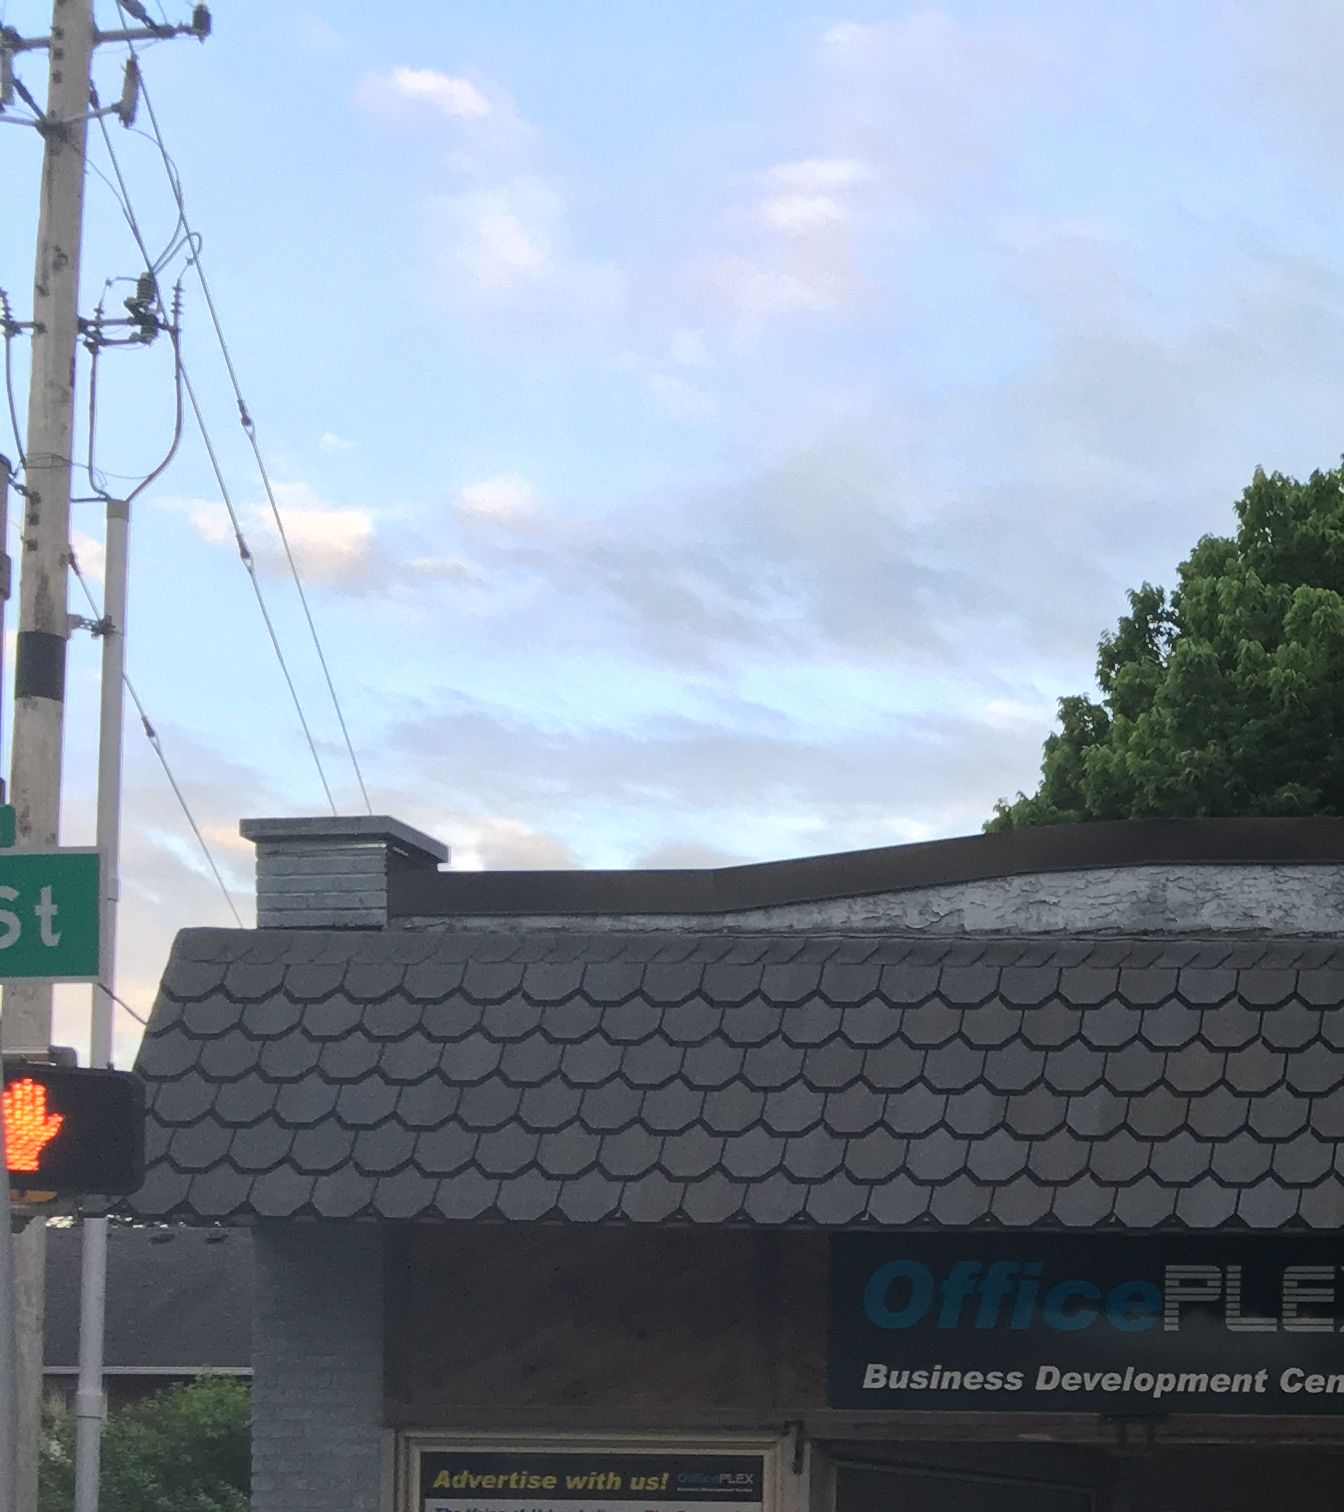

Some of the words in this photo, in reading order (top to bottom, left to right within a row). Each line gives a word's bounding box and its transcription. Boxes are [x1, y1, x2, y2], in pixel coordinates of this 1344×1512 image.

[862, 1363, 1024, 1391] Business
[1035, 1365, 1269, 1397] Development
[433, 1470, 557, 1489] Advertise
[565, 1471, 622, 1490] with
[630, 1472, 669, 1491] us!
